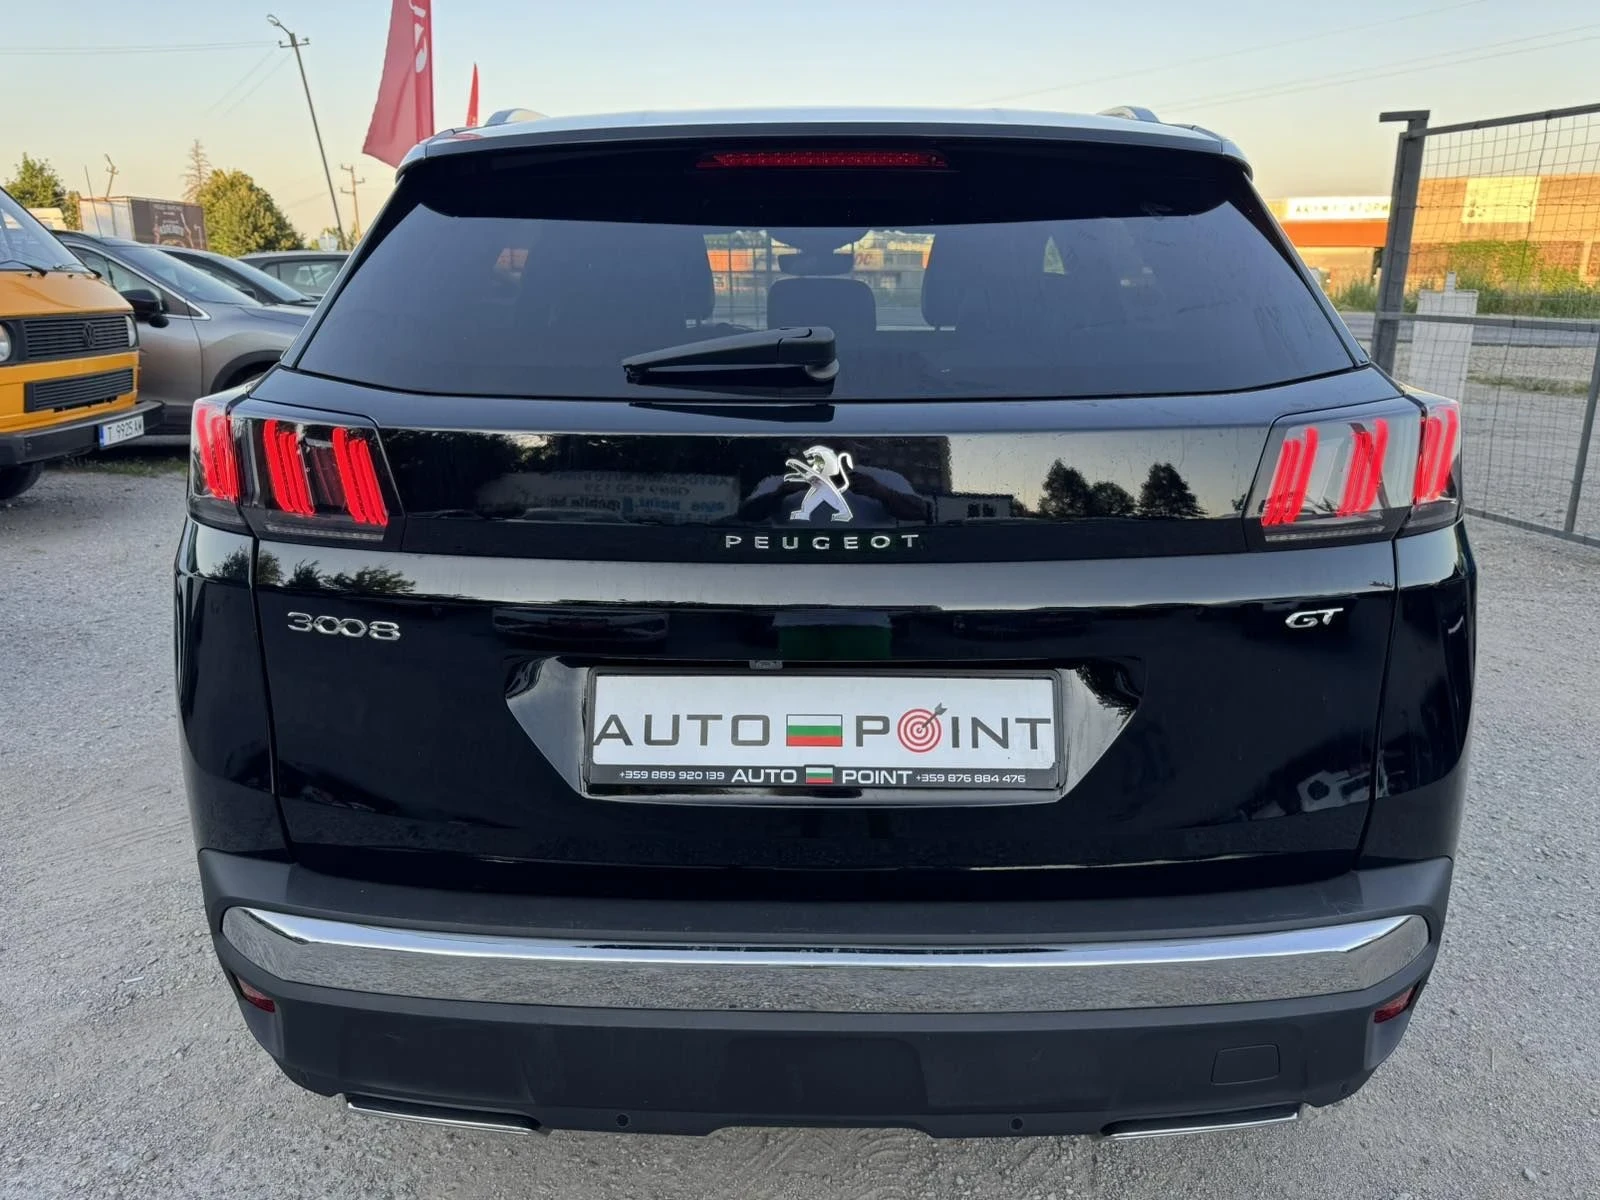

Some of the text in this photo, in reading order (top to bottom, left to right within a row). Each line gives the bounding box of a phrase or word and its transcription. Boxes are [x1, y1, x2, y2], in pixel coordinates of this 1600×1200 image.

[116, 420, 134, 440] 9925
[725, 534, 919, 549] PEUGEOT
[287, 611, 400, 640] 3008
[1285, 607, 1344, 629] GT
[593, 714, 770, 747] AUTO
[619, 768, 1026, 784] +359 889 920 139 AUTO POINT +359 876 884 476
